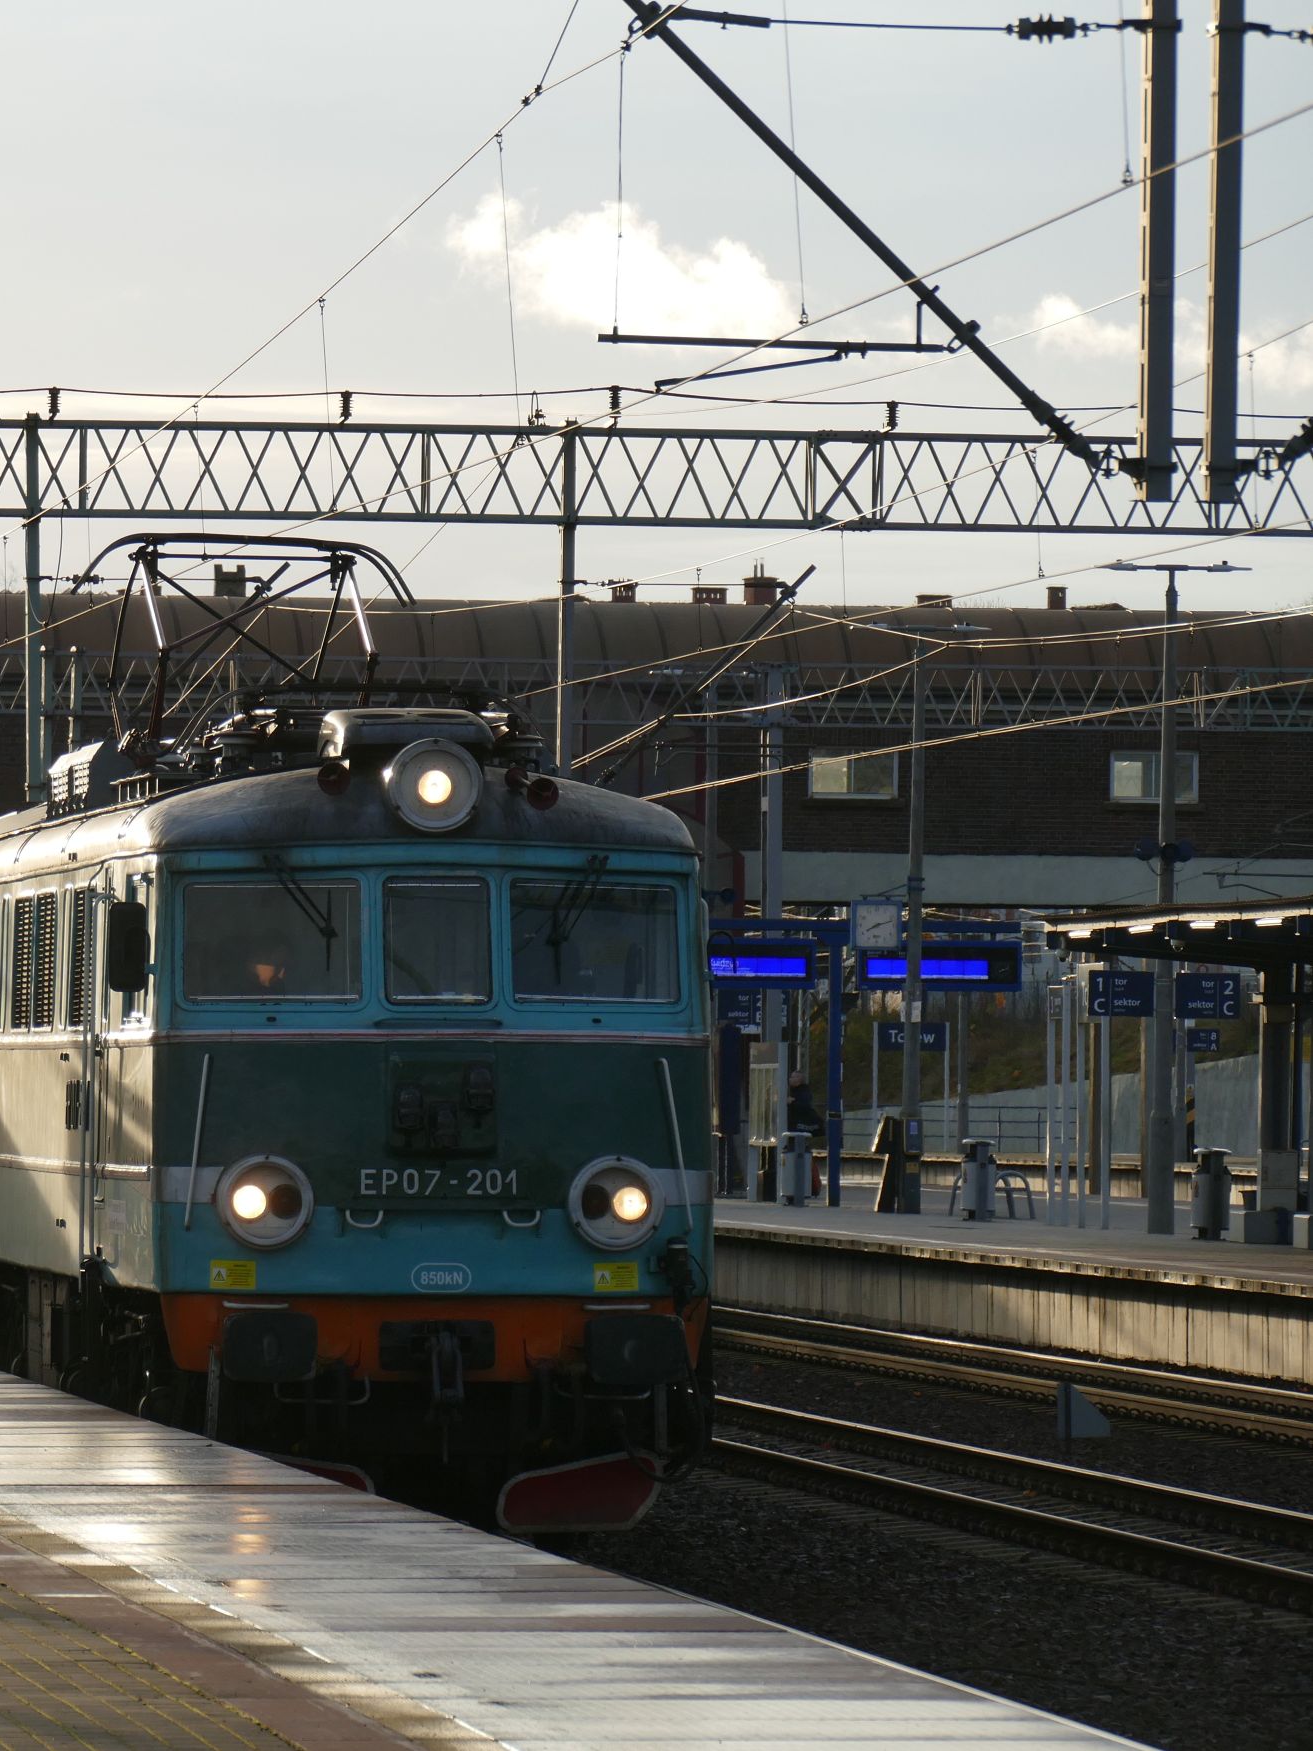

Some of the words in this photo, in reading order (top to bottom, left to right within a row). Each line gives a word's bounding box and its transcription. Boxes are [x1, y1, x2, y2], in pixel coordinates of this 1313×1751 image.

[1096, 977, 1103, 992] 1
[1115, 978, 1128, 986] tor
[1201, 980, 1214, 988] tor
[1223, 980, 1234, 995] 2
[1093, 998, 1106, 1013] C
[1114, 997, 1141, 1007] sektor
[1188, 1000, 1214, 1009] sektor
[1223, 1001, 1234, 1016] C
[360, 1168, 517, 1196] EP07-201
[420, 1271, 463, 1285] 850kN
